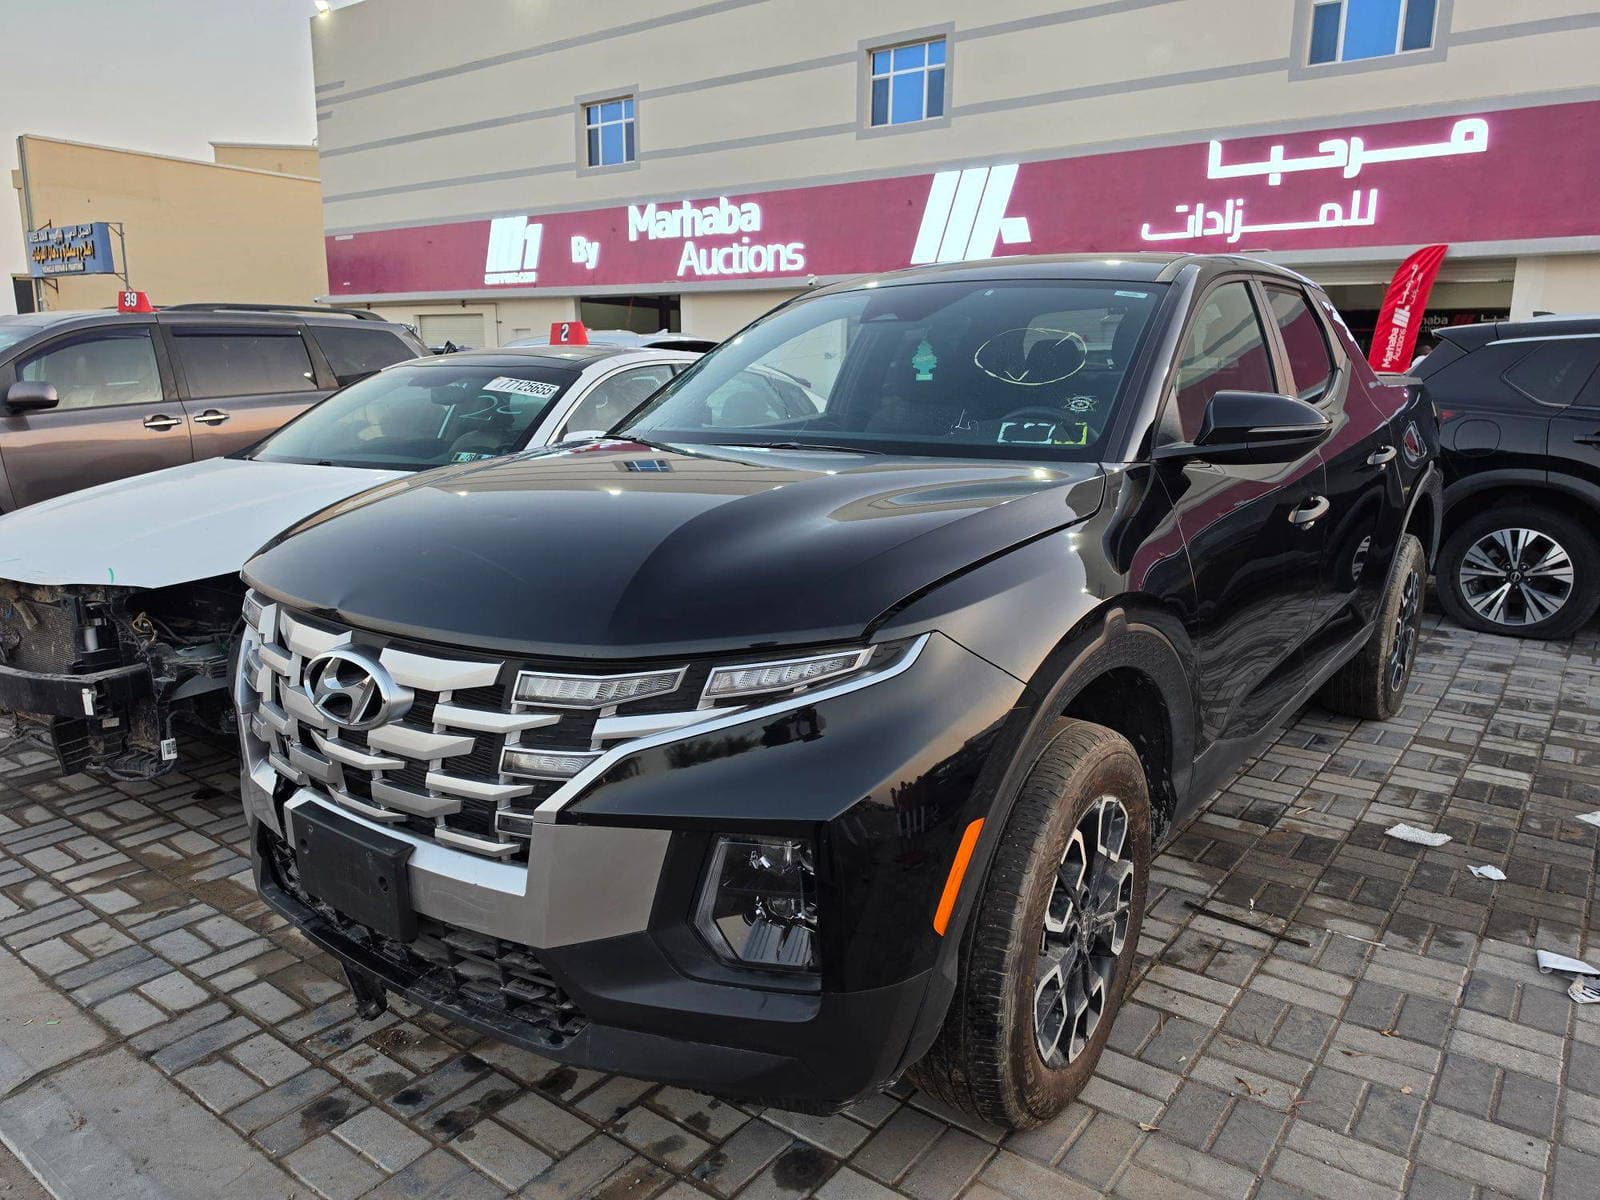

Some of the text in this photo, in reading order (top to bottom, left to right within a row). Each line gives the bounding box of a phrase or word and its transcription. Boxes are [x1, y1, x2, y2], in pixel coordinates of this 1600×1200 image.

[1207, 118, 1488, 185] مرحبا
[628, 197, 761, 241] Marhaba
[1140, 188, 1379, 244] للمزادات
[570, 235, 600, 269] By
[676, 237, 806, 276] Auctions
[124, 292, 137, 307] 39
[561, 324, 569, 342] 2
[1382, 328, 1399, 367] Marhaba
